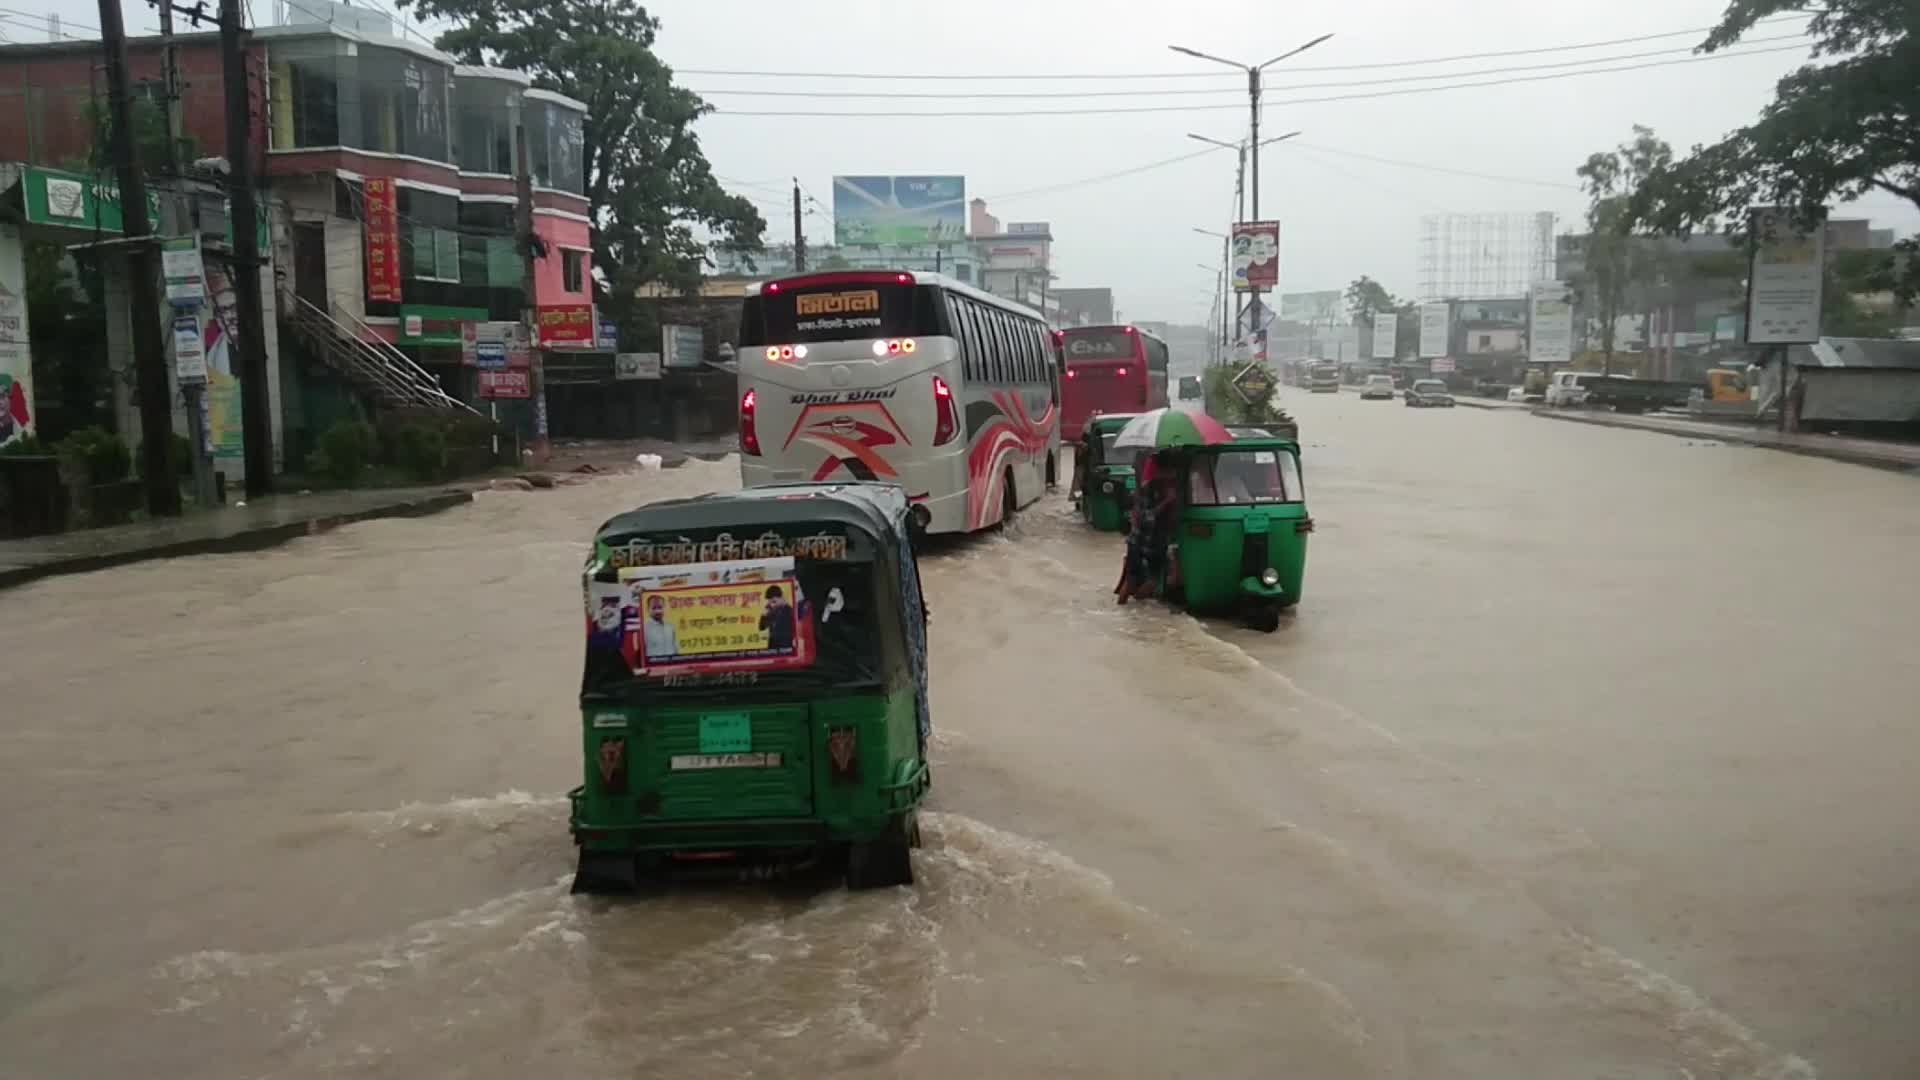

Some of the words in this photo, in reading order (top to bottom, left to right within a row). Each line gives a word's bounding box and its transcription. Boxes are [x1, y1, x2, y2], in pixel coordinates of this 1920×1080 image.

[796, 289, 880, 315] মিতালী
[790, 392, 841, 405] Bhai
[846, 387, 897, 402] Bhai
